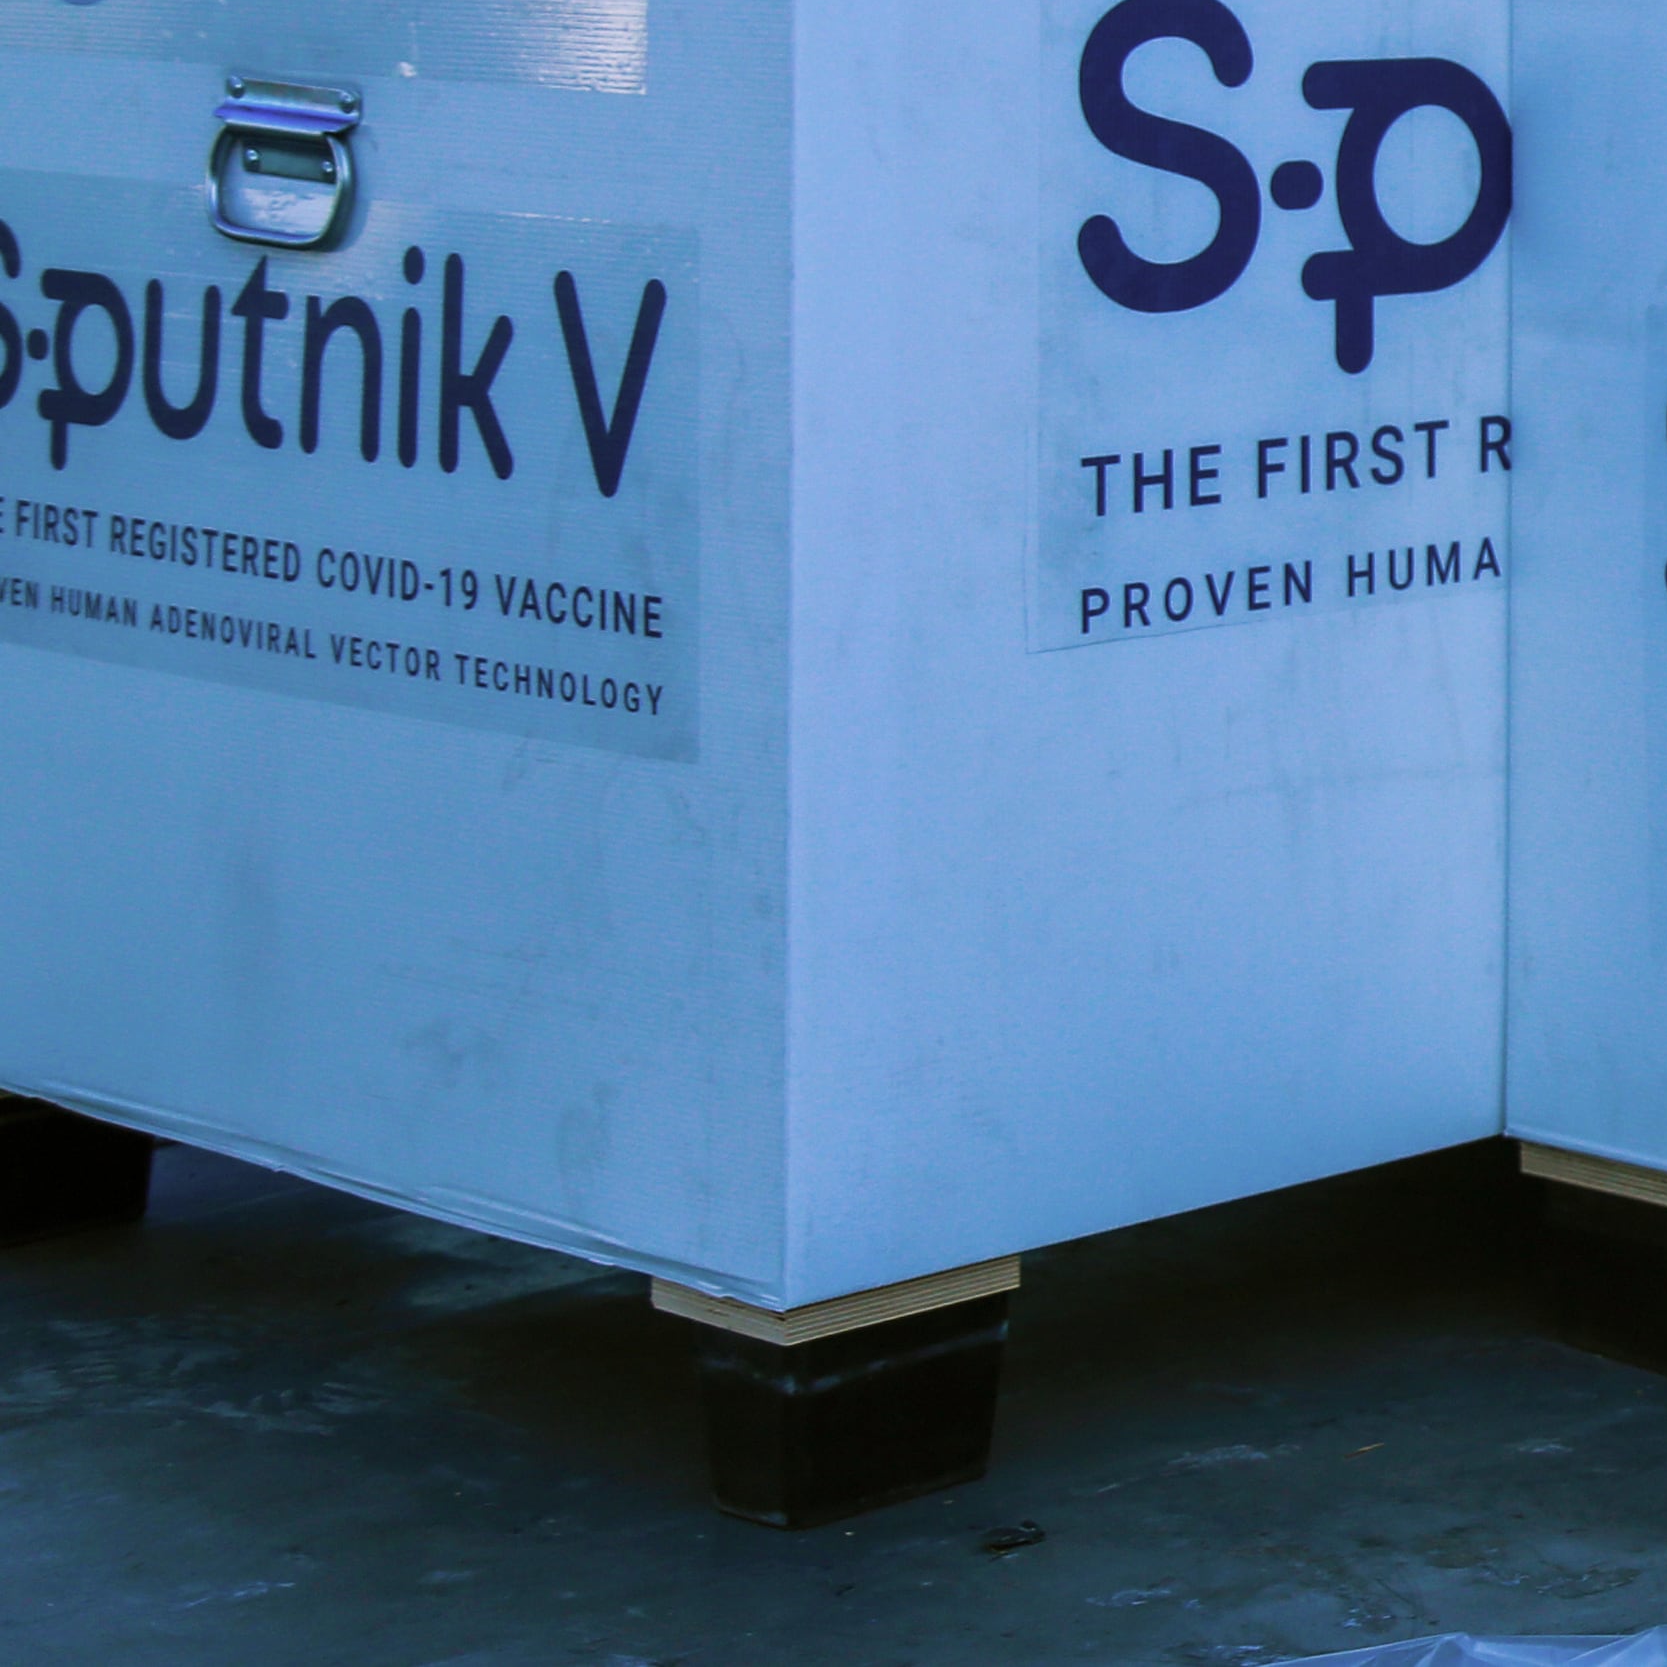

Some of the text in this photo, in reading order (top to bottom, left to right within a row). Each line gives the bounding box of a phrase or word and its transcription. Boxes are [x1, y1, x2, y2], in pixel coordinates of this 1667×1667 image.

[0, 218, 667, 497] putnik V
[1080, 442, 1223, 517] THE
[1257, 419, 1450, 499] FIRST
[16, 500, 99, 548] FIRST
[111, 515, 301, 582] REGISTERED
[317, 549, 479, 610] COVID-19
[496, 574, 663, 638] VACCINE
[1080, 560, 1313, 635] PROVEN
[51, 585, 137, 627] HUMAN
[150, 602, 317, 659] ADENOVIRAL
[329, 635, 441, 681] VECTOR
[455, 653, 664, 715] TECHNOLOGY
